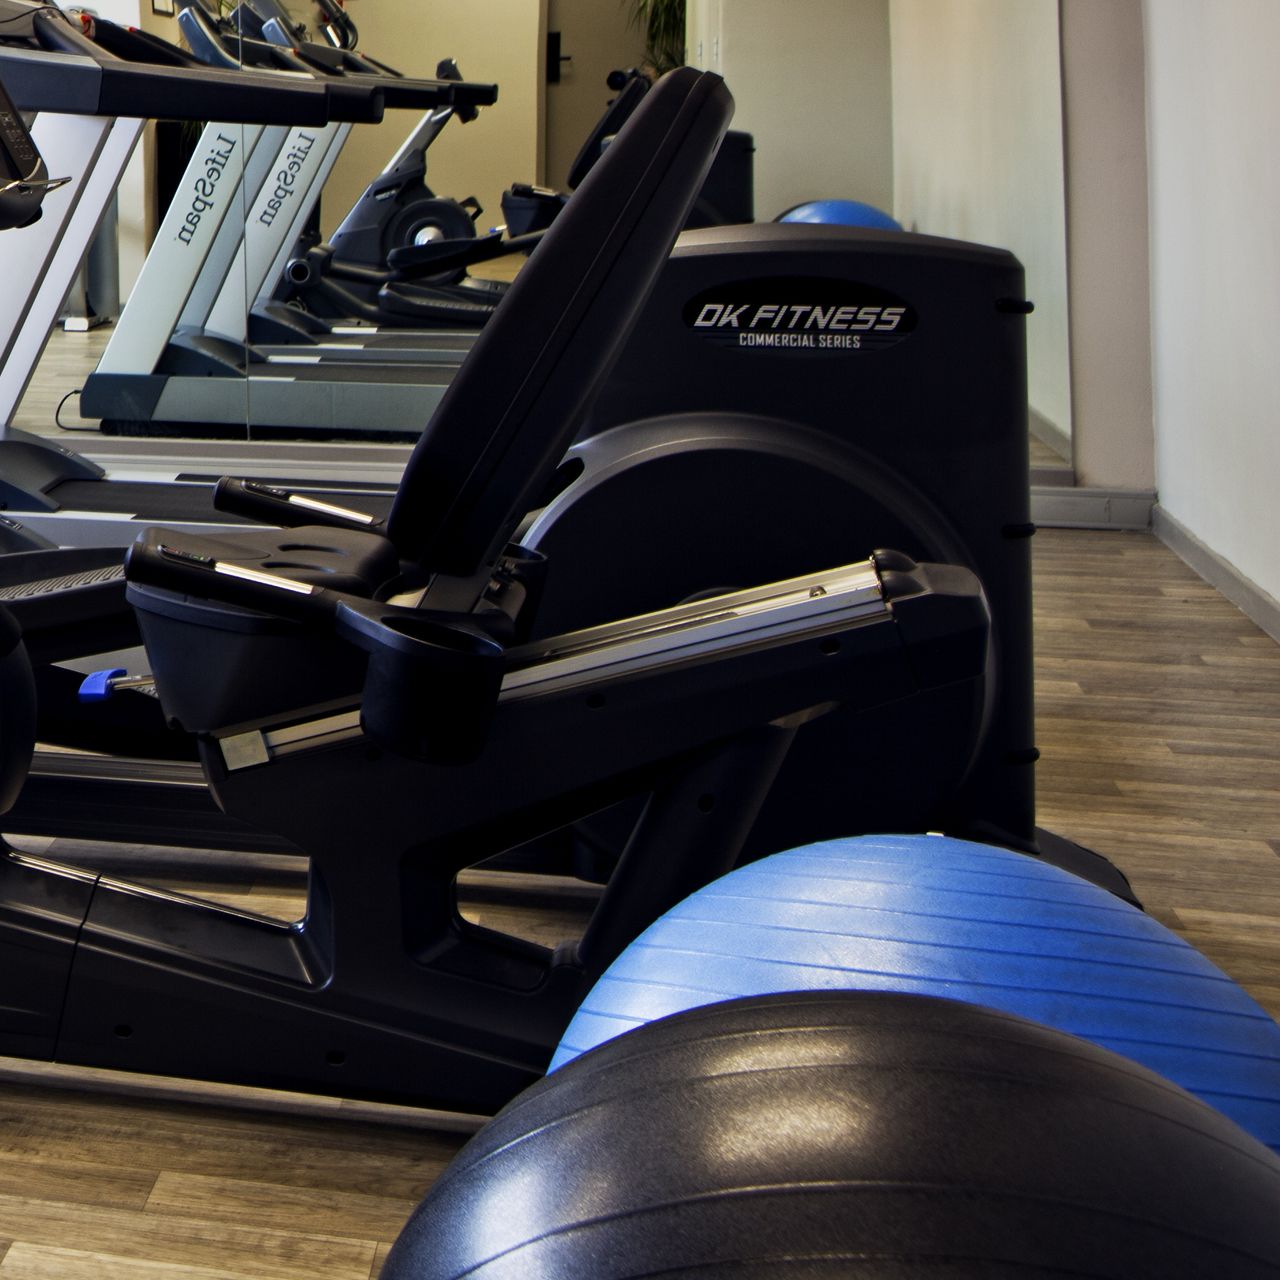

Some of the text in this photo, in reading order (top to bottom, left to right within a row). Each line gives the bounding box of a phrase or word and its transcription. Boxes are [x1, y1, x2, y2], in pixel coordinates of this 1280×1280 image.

[748, 305, 907, 331] FITNESS
[739, 332, 861, 349] COMMERCIAL SERIES
